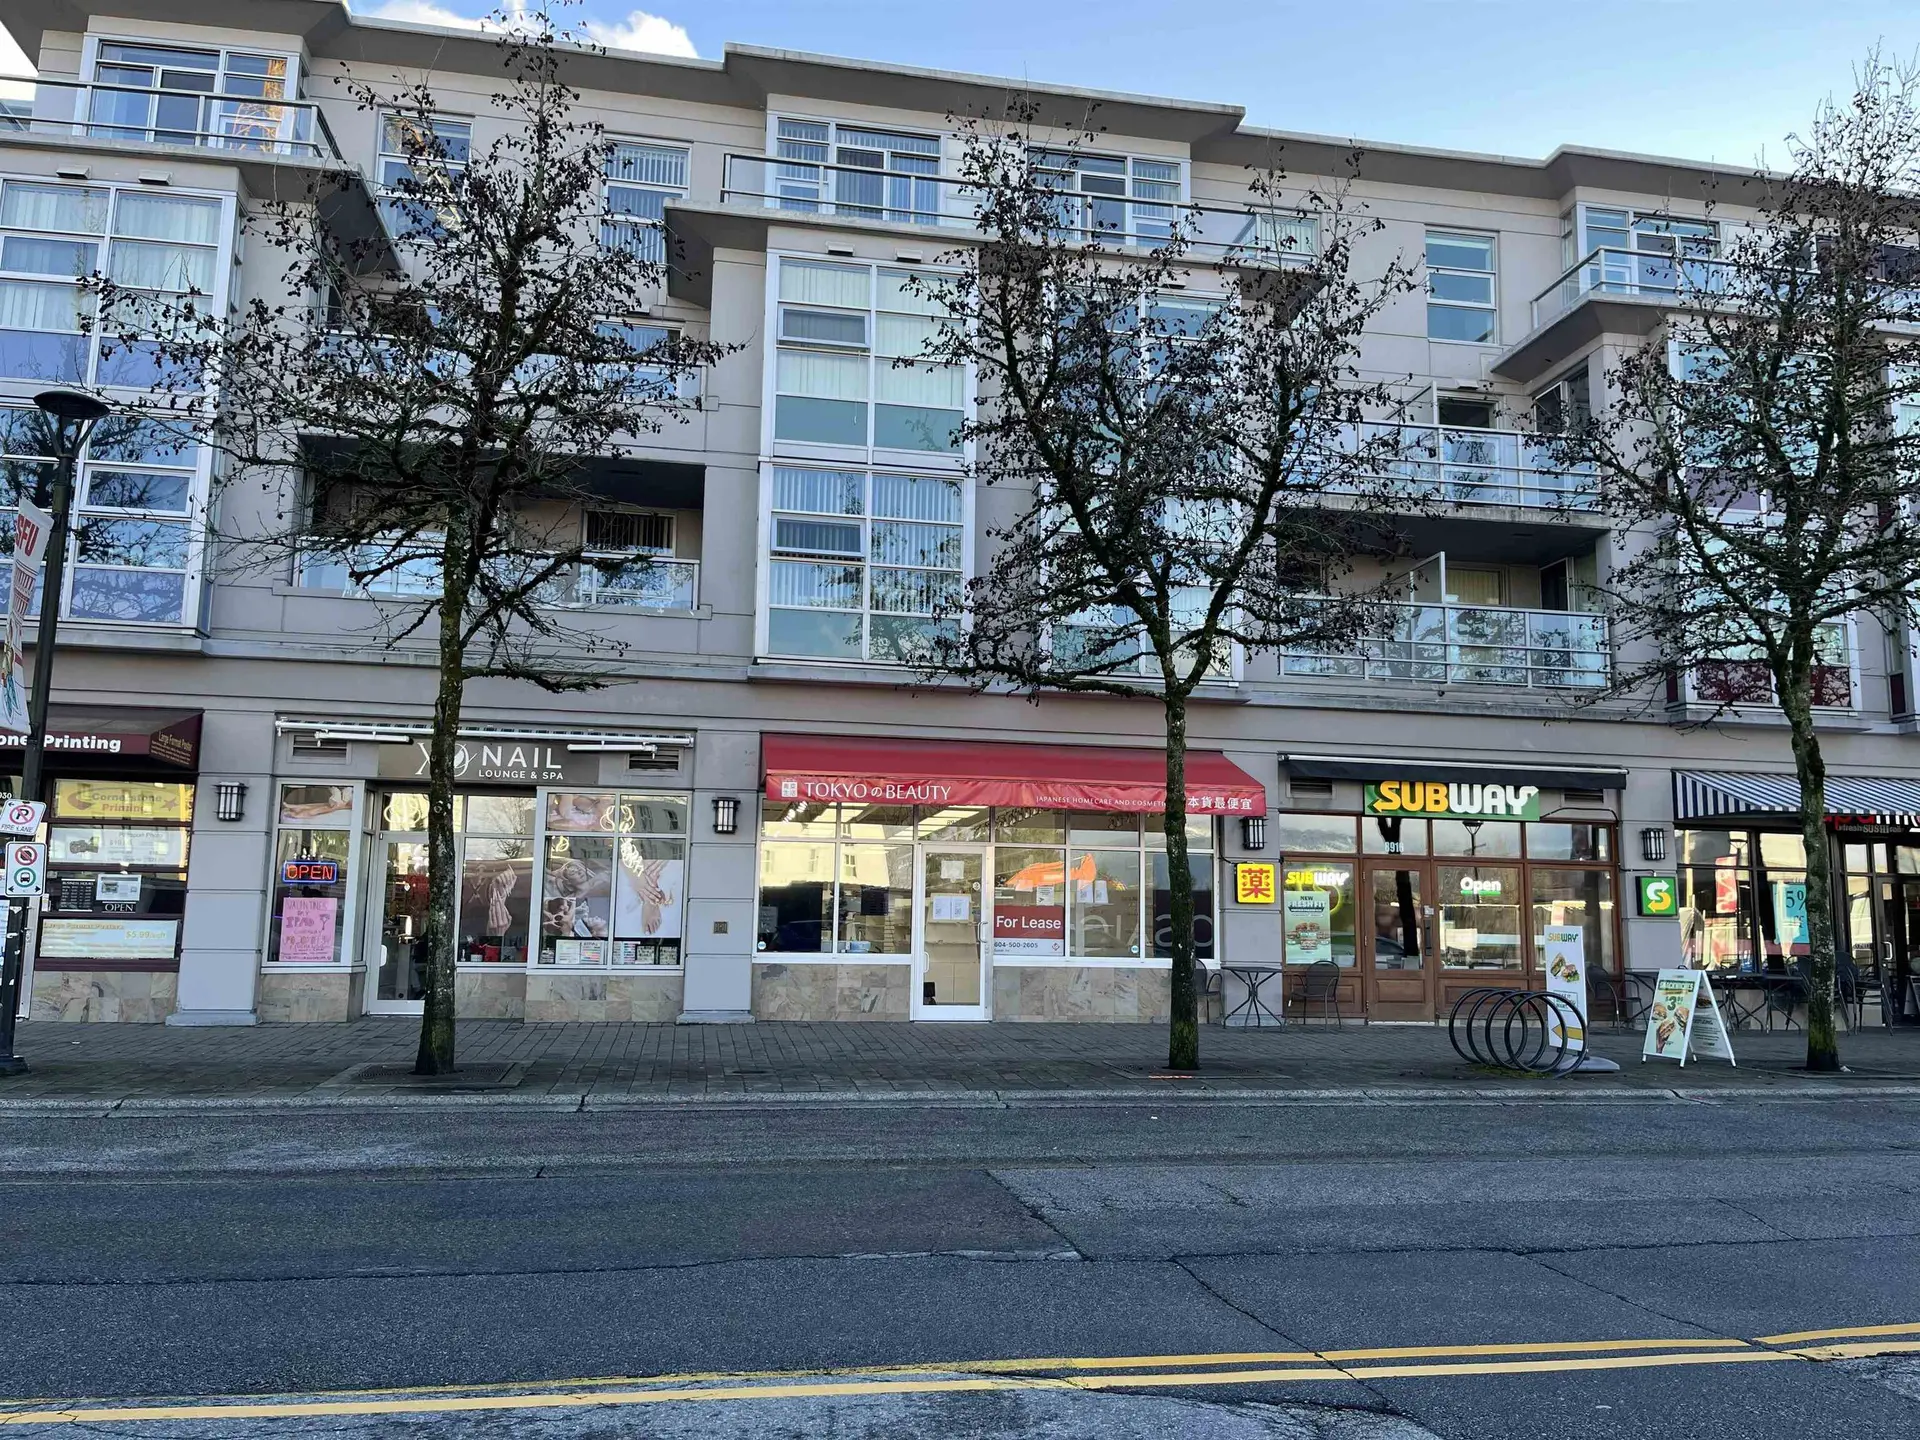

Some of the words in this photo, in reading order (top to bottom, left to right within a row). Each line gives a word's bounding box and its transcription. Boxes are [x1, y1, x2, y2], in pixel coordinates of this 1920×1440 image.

[15, 513, 40, 557] SFU
[43, 734, 122, 752] Printing
[482, 745, 562, 769] NAIL
[478, 769, 526, 779] LOUNGE
[530, 771, 538, 780] &
[542, 771, 564, 780] SPA
[92, 792, 162, 802] Cornestone
[804, 782, 867, 798] TOKYO
[871, 786, 882, 798] の
[886, 784, 951, 800] BEAUTY
[1373, 780, 1540, 815] SUBWAY
[1036, 795, 1070, 804] JAPANESE
[1072, 796, 1112, 805] HOMECARE
[1132, 799, 1166, 808] COSMETI
[1187, 795, 1253, 810] 本貨最便宜
[17, 825, 33, 833] LANE
[1863, 826, 1889, 834] SUSHI
[287, 864, 334, 880] OPEN
[1285, 870, 1350, 886] SUBWAY
[1241, 867, 1271, 899] 薬
[1460, 876, 1501, 894] Open
[105, 904, 134, 912] OPEN
[1287, 900, 1313, 908] FRESH
[996, 915, 1018, 928] For
[1022, 916, 1062, 929] Lease
[1548, 932, 1579, 942] SUBWAY
